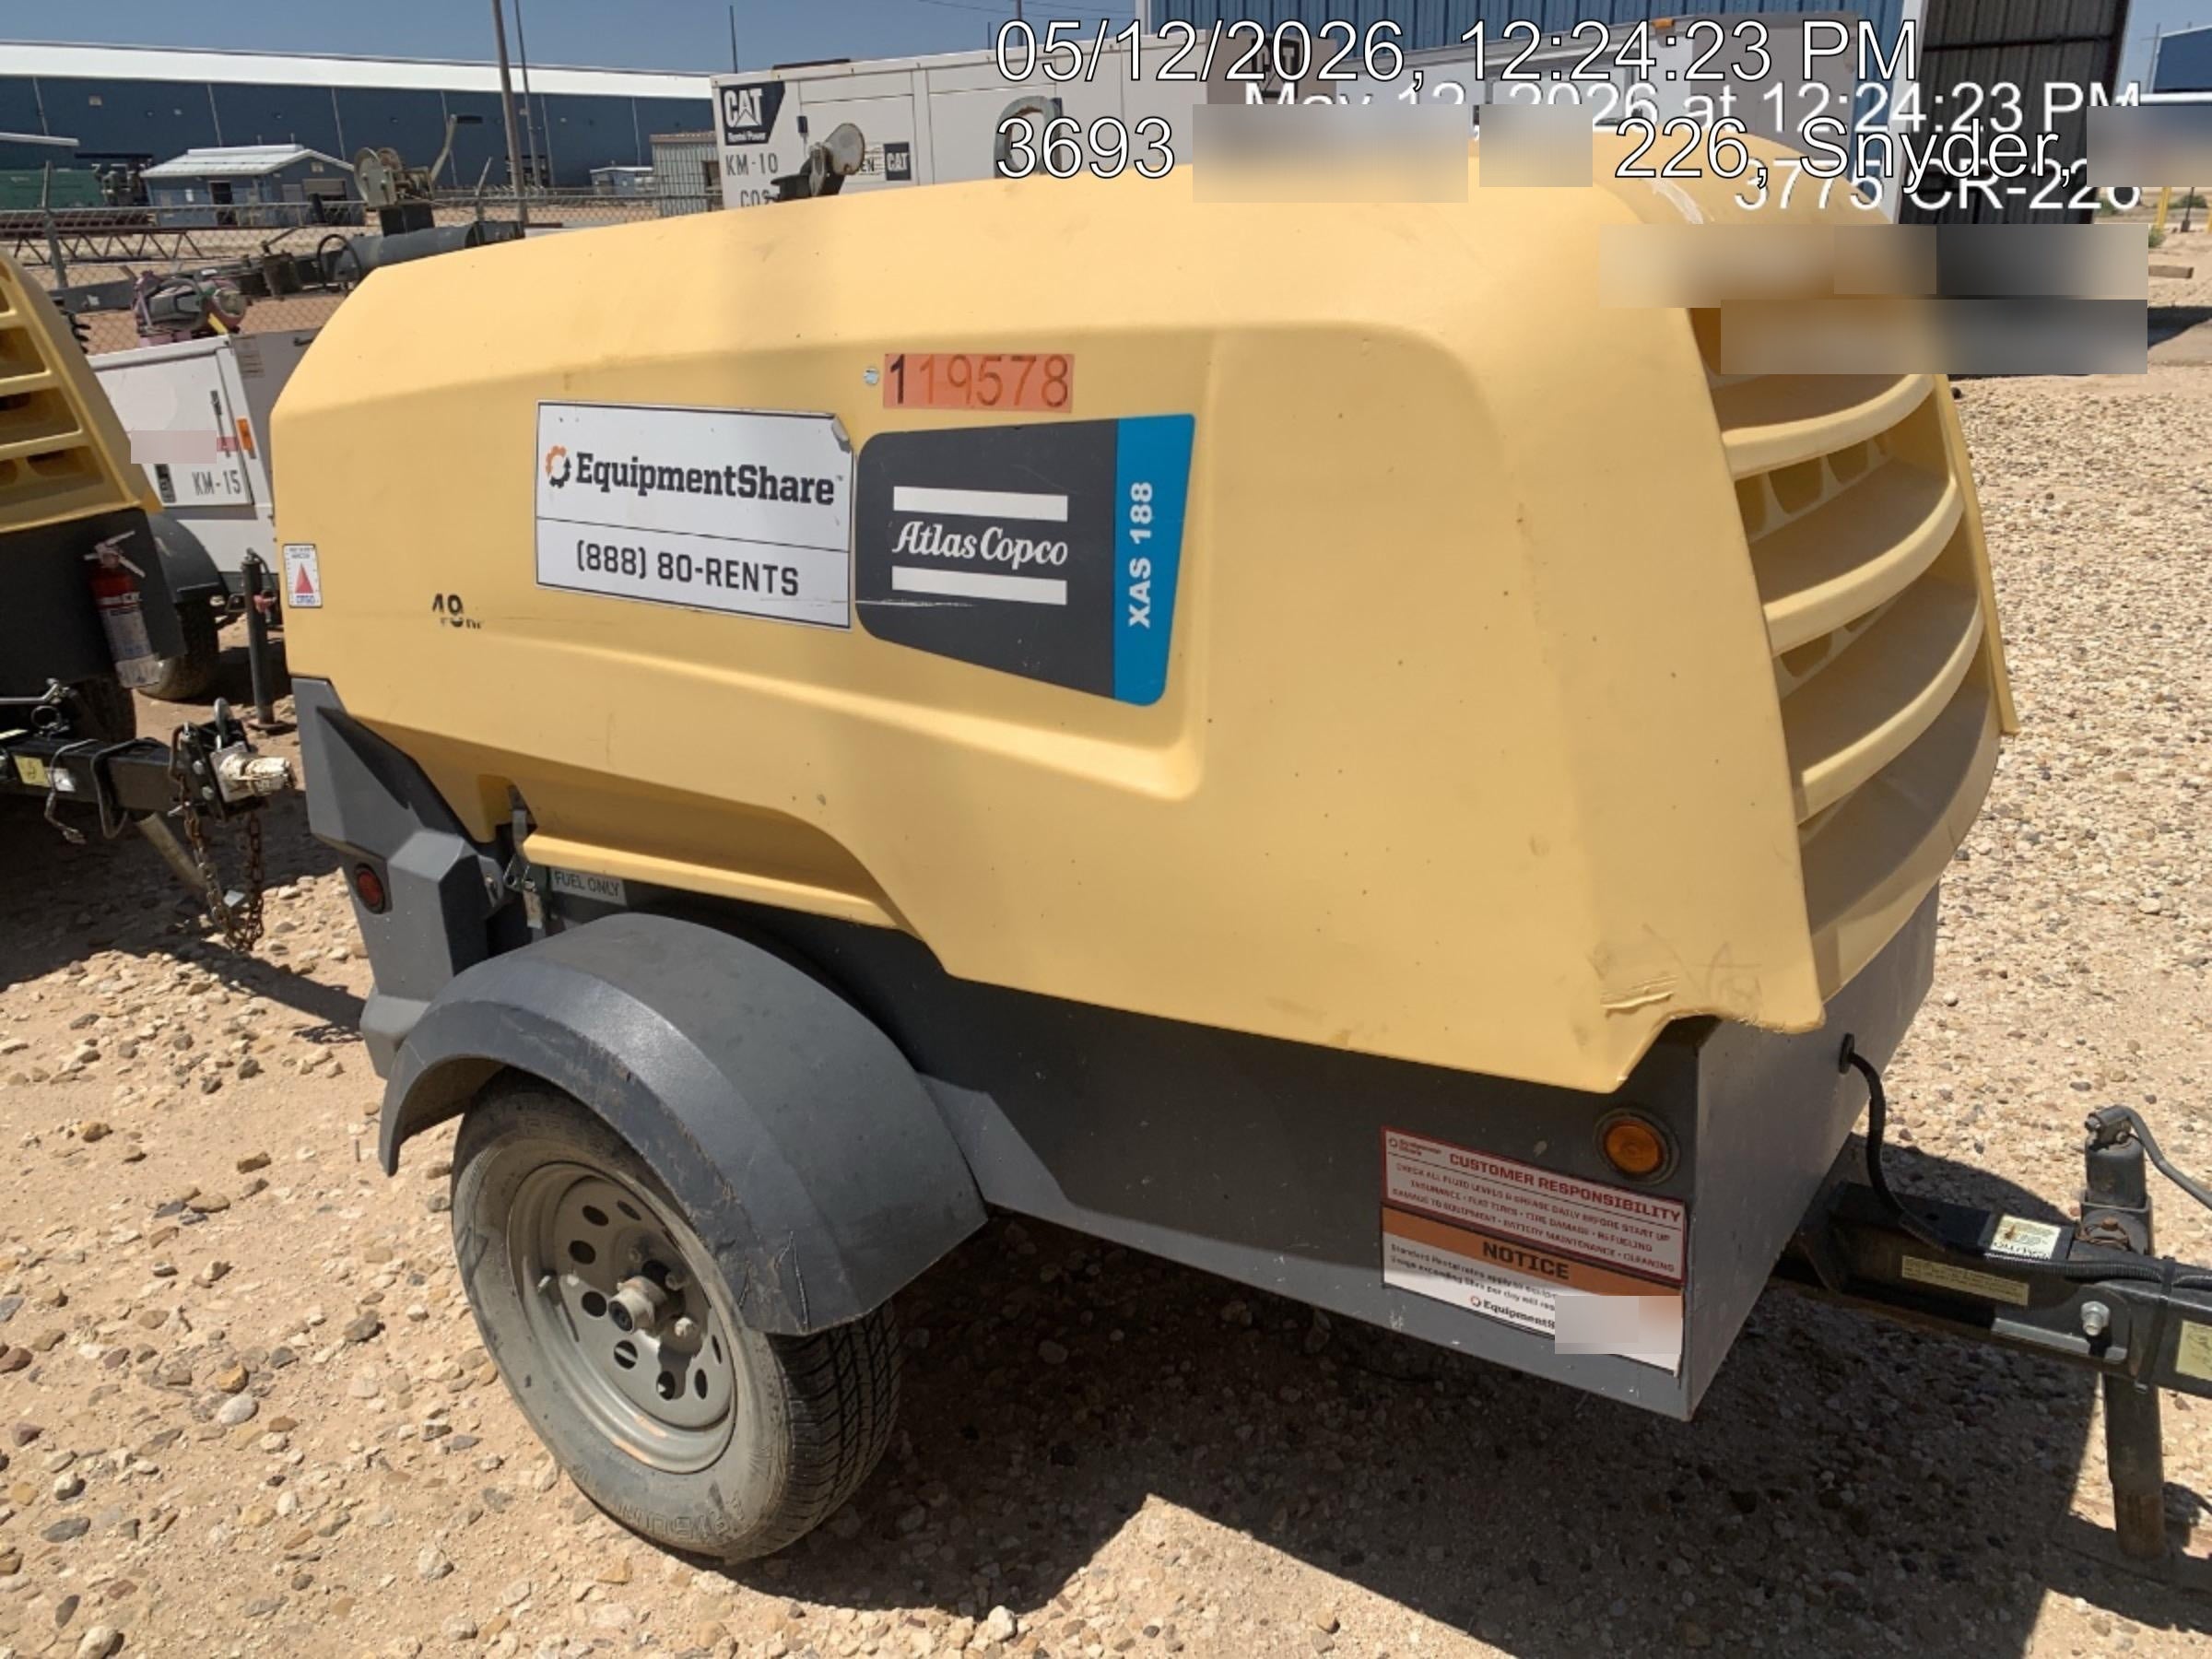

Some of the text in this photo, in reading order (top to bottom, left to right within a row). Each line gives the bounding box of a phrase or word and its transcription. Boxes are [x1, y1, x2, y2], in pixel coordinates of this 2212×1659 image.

[724, 88, 763, 127] CAT
[725, 152, 779, 177] KM-10
[887, 152, 908, 171] CAT
[890, 353, 1069, 407] 119578
[191, 469, 241, 496] KM-15
[575, 451, 834, 506] EquipmentShare
[577, 540, 799, 596] (888) 80-RENTS
[1128, 482, 1154, 629] XAS 188
[555, 870, 620, 897] FUEL ONLY
[1442, 1175, 1469, 1190] FLUID
[1472, 1184, 1503, 1198] LEVELS
[1552, 1205, 1581, 1220] DAILY
[1621, 1223, 1653, 1239] START
[1449, 1153, 1681, 1223] CUSTOMER RESPONSIBILITY
[1483, 1241, 1570, 1280] NOTICE
[1547, 1230, 1616, 1257] MAINTENANCE
